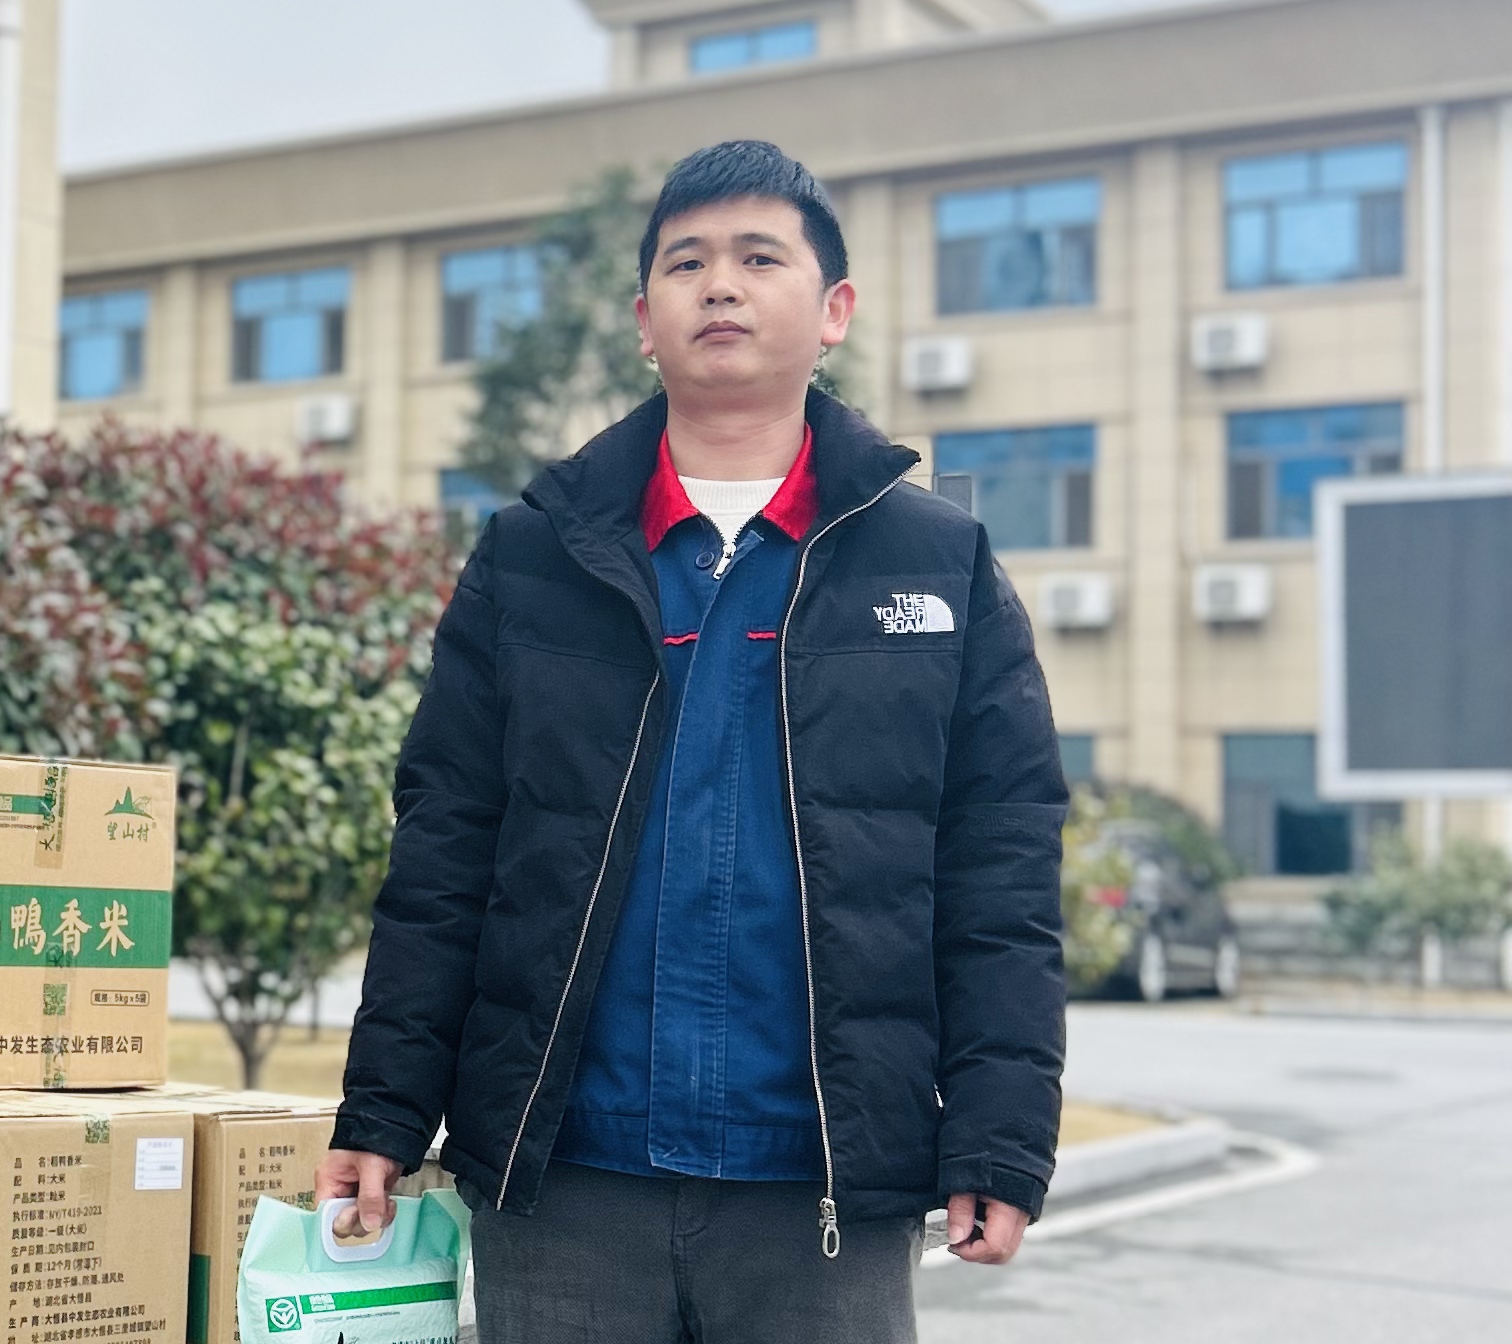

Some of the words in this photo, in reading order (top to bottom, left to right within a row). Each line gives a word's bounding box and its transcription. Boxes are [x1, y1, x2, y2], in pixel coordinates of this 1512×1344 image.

[892, 594, 925, 607] THE
[107, 822, 150, 843] 望山村
